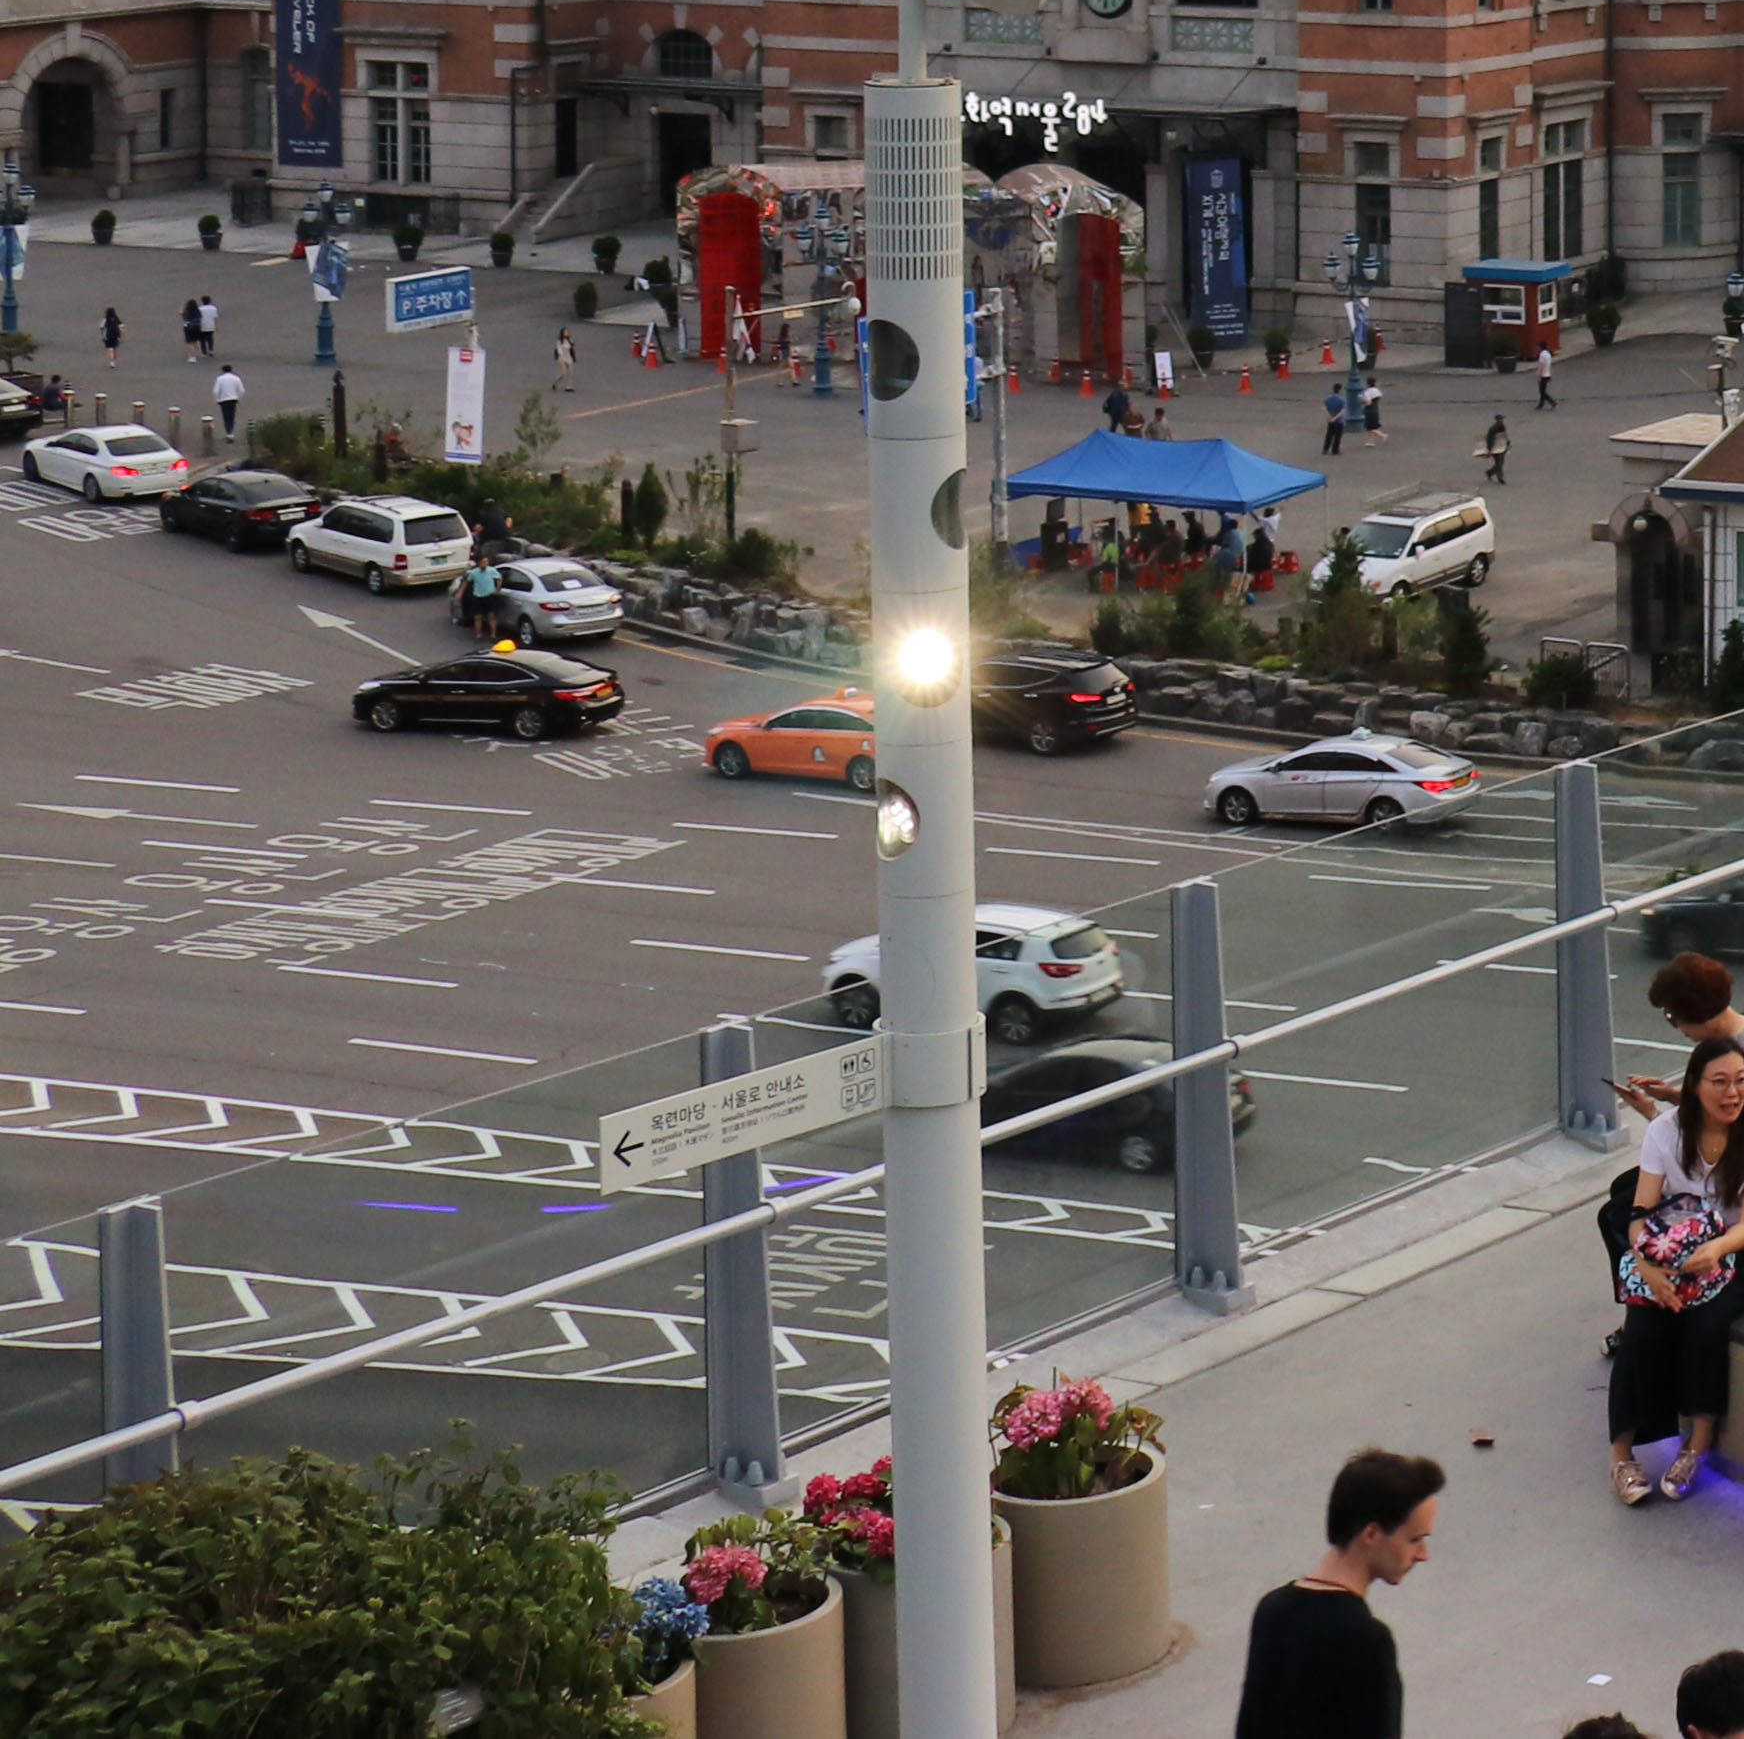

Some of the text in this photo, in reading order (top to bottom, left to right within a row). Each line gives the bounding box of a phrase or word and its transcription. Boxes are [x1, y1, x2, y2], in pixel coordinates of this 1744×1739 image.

[415, 291, 453, 313] 주차장
[651, 1102, 706, 1131] 목련마당
[721, 1085, 761, 1110] 서울로
[766, 1073, 806, 1099] 안내소
